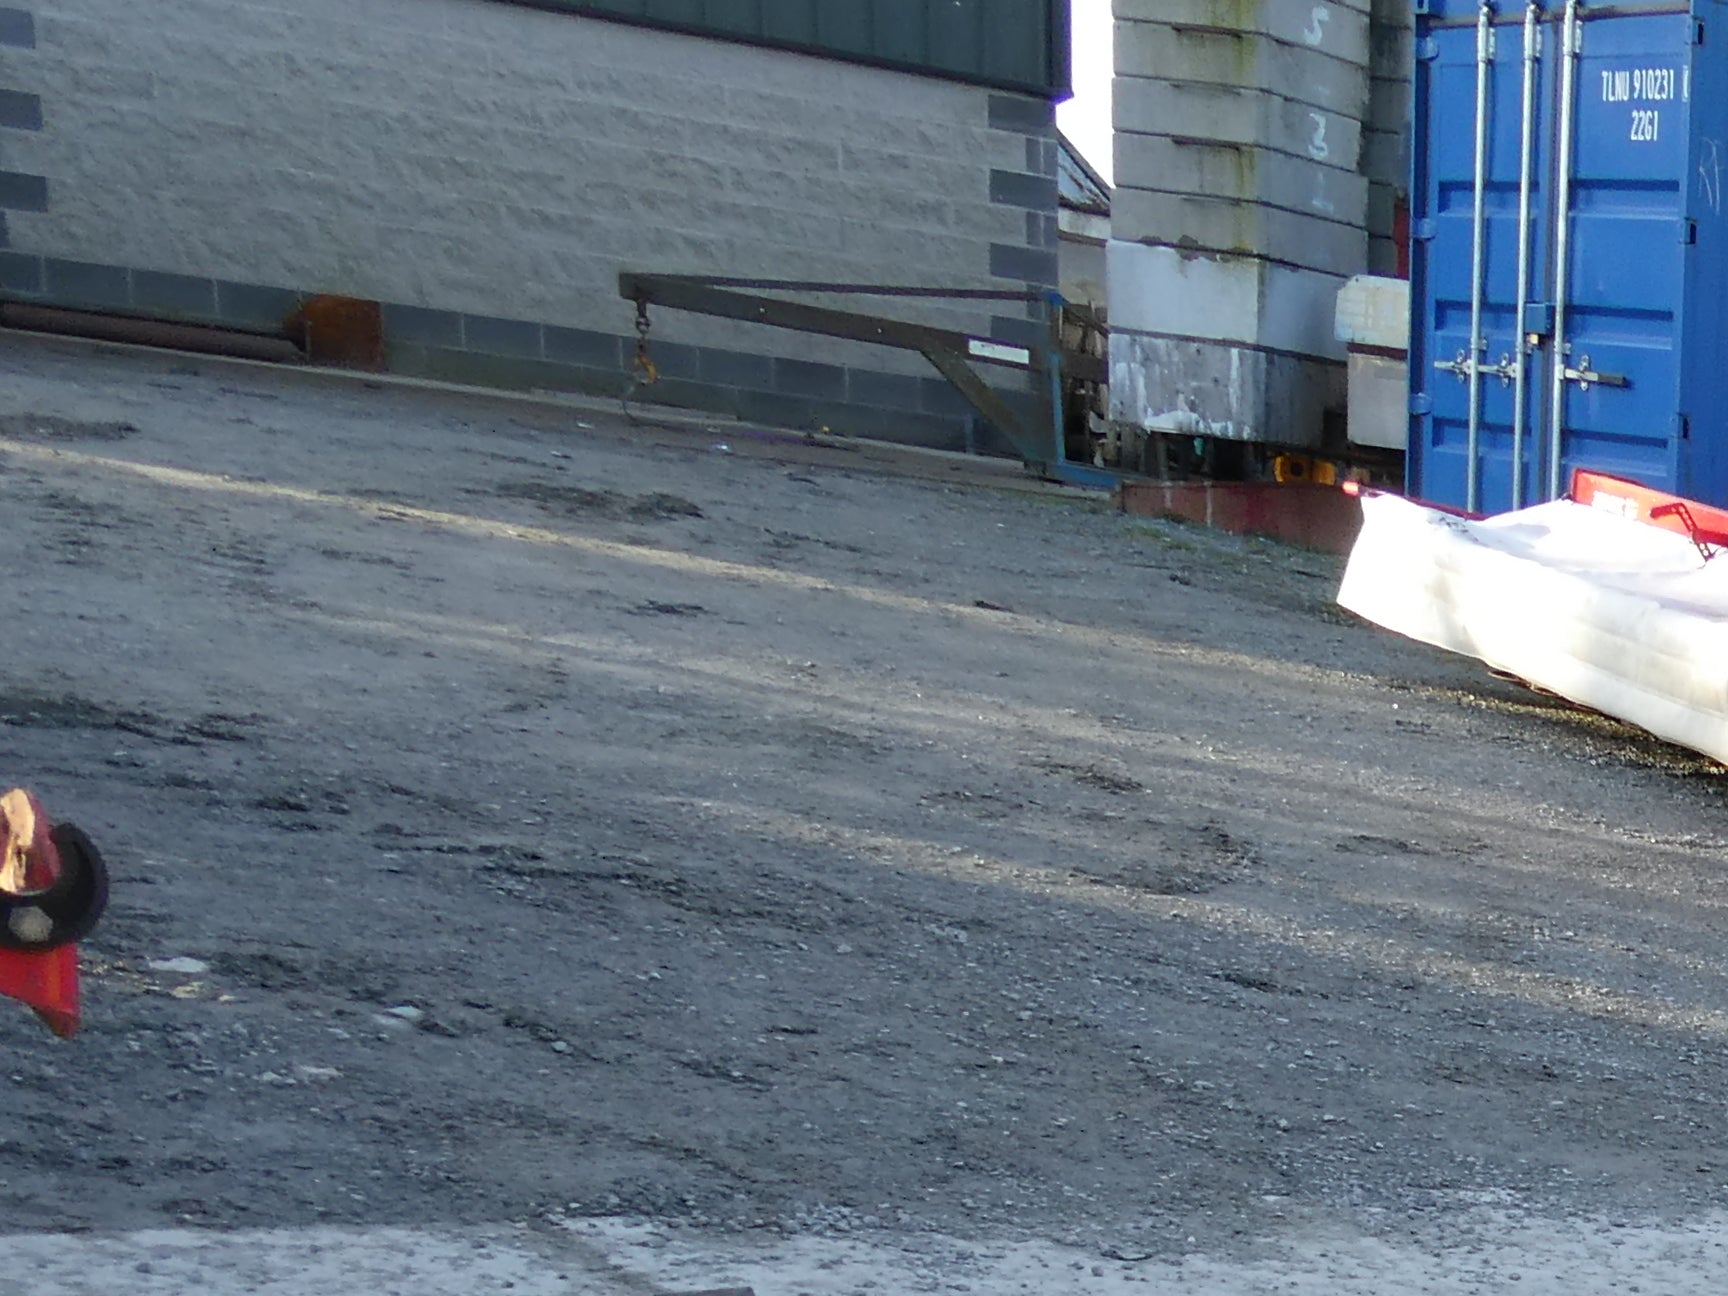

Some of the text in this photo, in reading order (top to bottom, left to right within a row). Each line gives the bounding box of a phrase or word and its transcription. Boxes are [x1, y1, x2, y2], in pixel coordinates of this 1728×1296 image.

[1601, 69, 1630, 102] TLNU
[1633, 68, 1675, 101] 910231
[1630, 109, 1659, 142] 22G1
